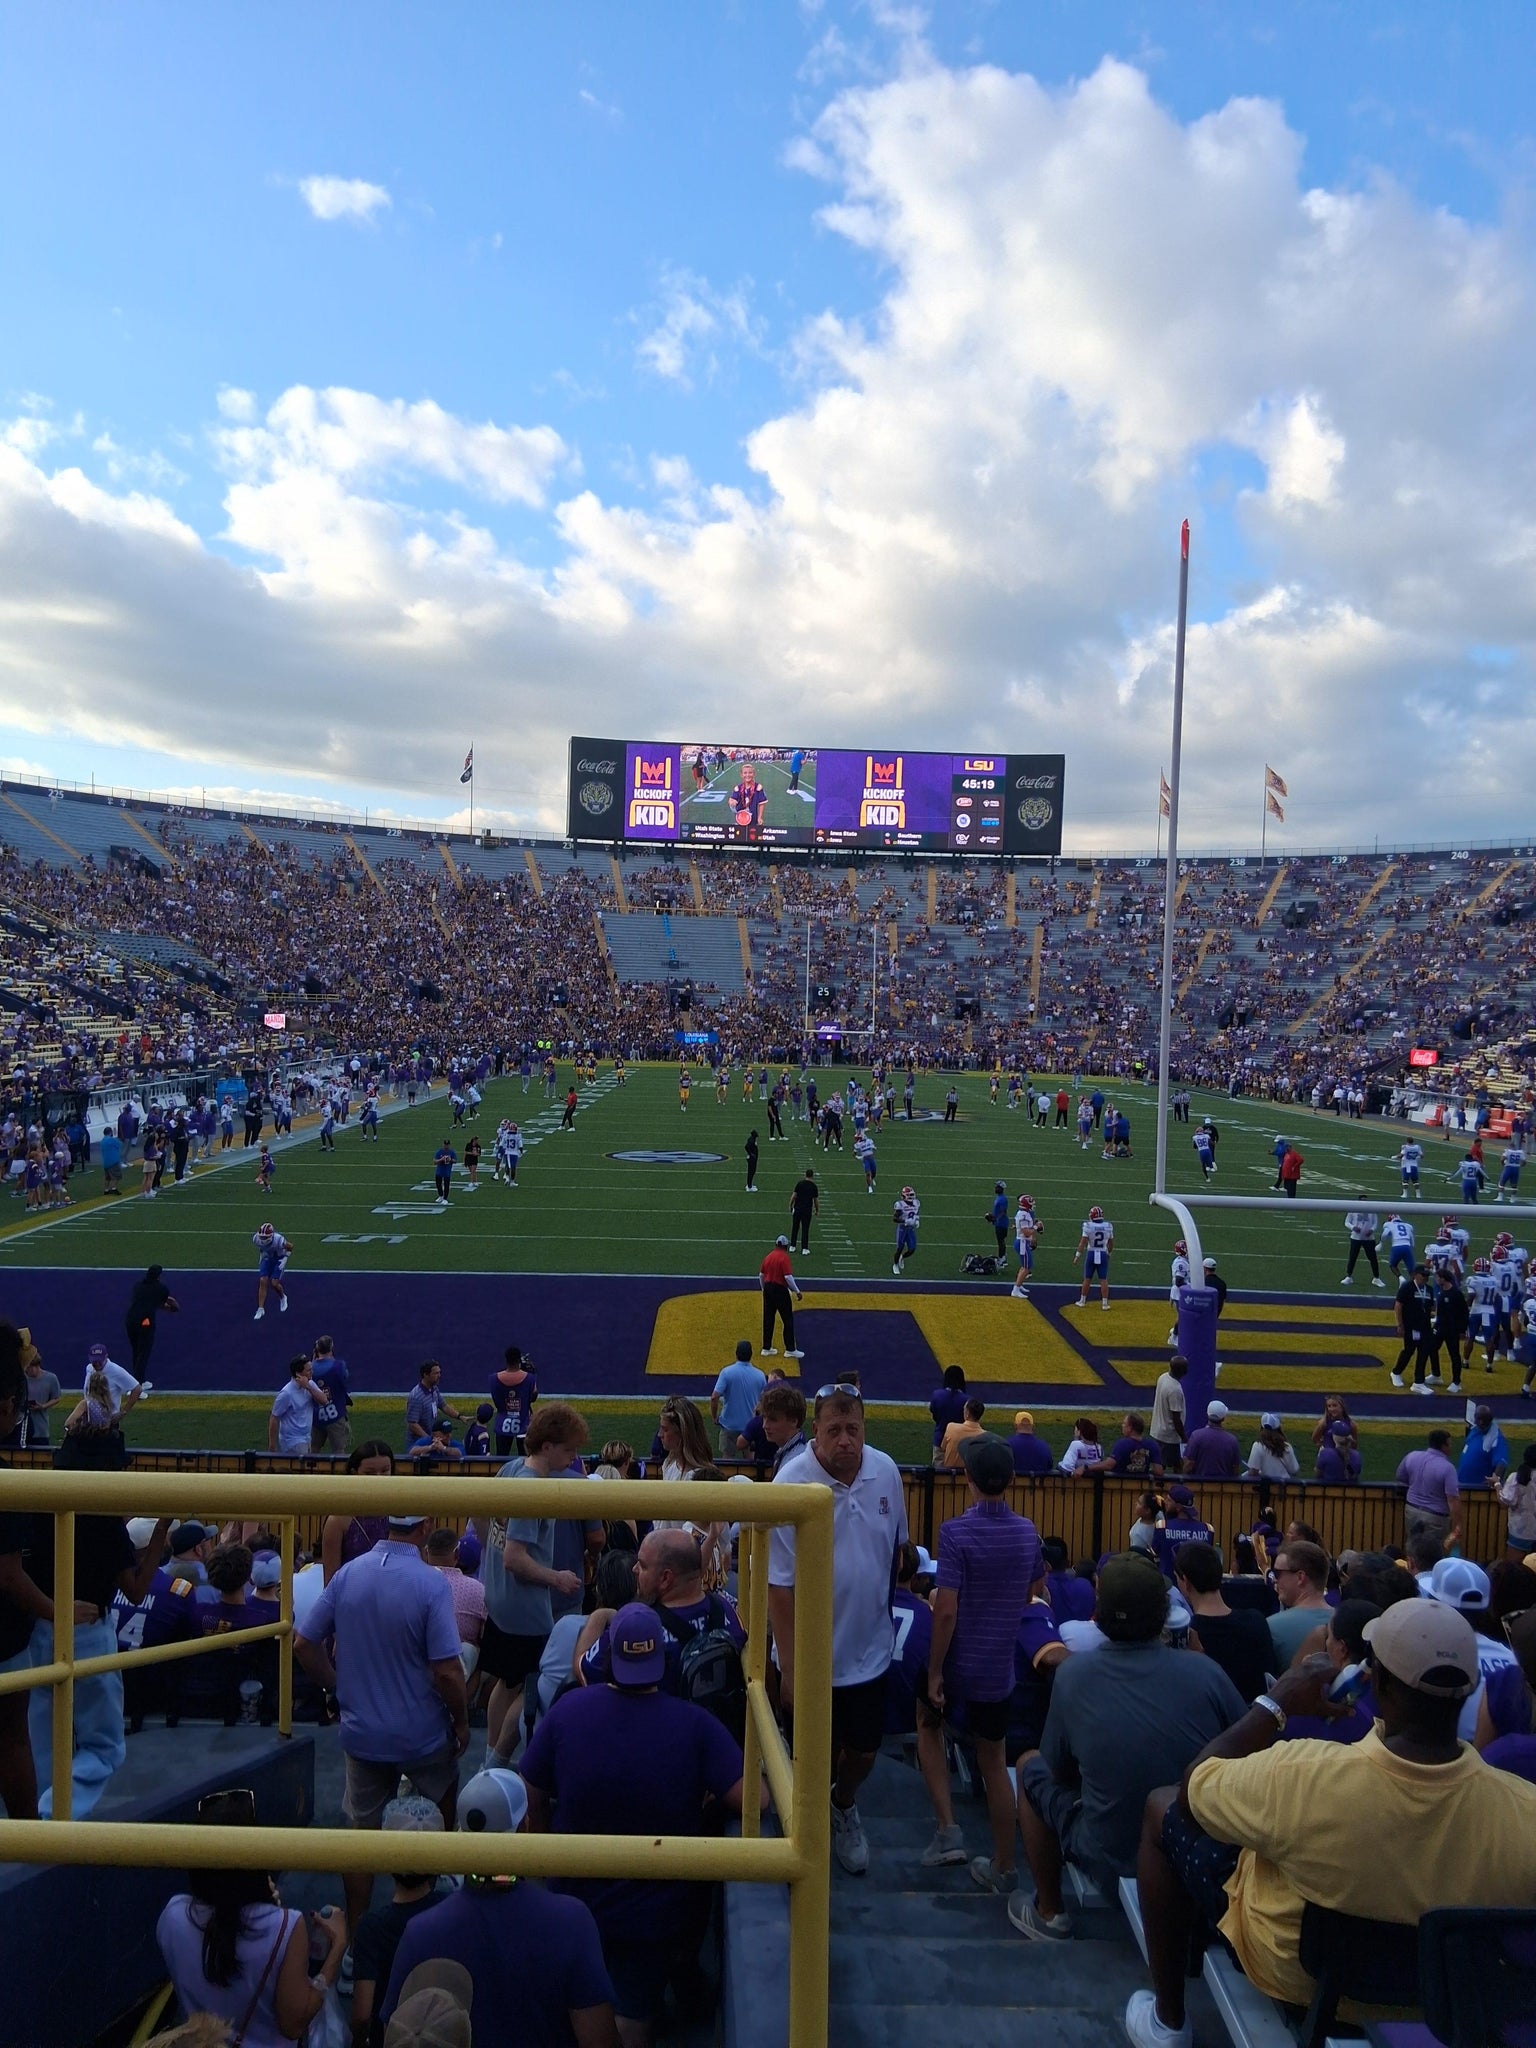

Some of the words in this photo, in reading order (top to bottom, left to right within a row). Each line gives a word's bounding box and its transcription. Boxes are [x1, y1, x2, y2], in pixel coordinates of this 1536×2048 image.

[964, 760, 994, 771] LSU
[962, 779, 995, 790] 45:19
[634, 788, 673, 800] KICKOFF
[863, 788, 905, 800] KICKOFF
[636, 805, 668, 826] KID
[867, 805, 899, 826] KID
[1331, 856, 1348, 864] 239
[1451, 850, 1469, 860] 240
[1047, 859, 1062, 867] 26
[1135, 859, 1151, 867] 237
[1230, 858, 1246, 866] 238
[817, 987, 830, 996] 25
[506, 1139, 516, 1149] 13
[1094, 1231, 1105, 1248] 2
[318, 1403, 339, 1421] 48
[502, 1418, 521, 1434] 66
[1165, 1529, 1209, 1541] BURREAUX
[891, 1605, 914, 1661] 7
[623, 1639, 655, 1653] LSU
[1436, 1651, 1458, 1659] POLO
